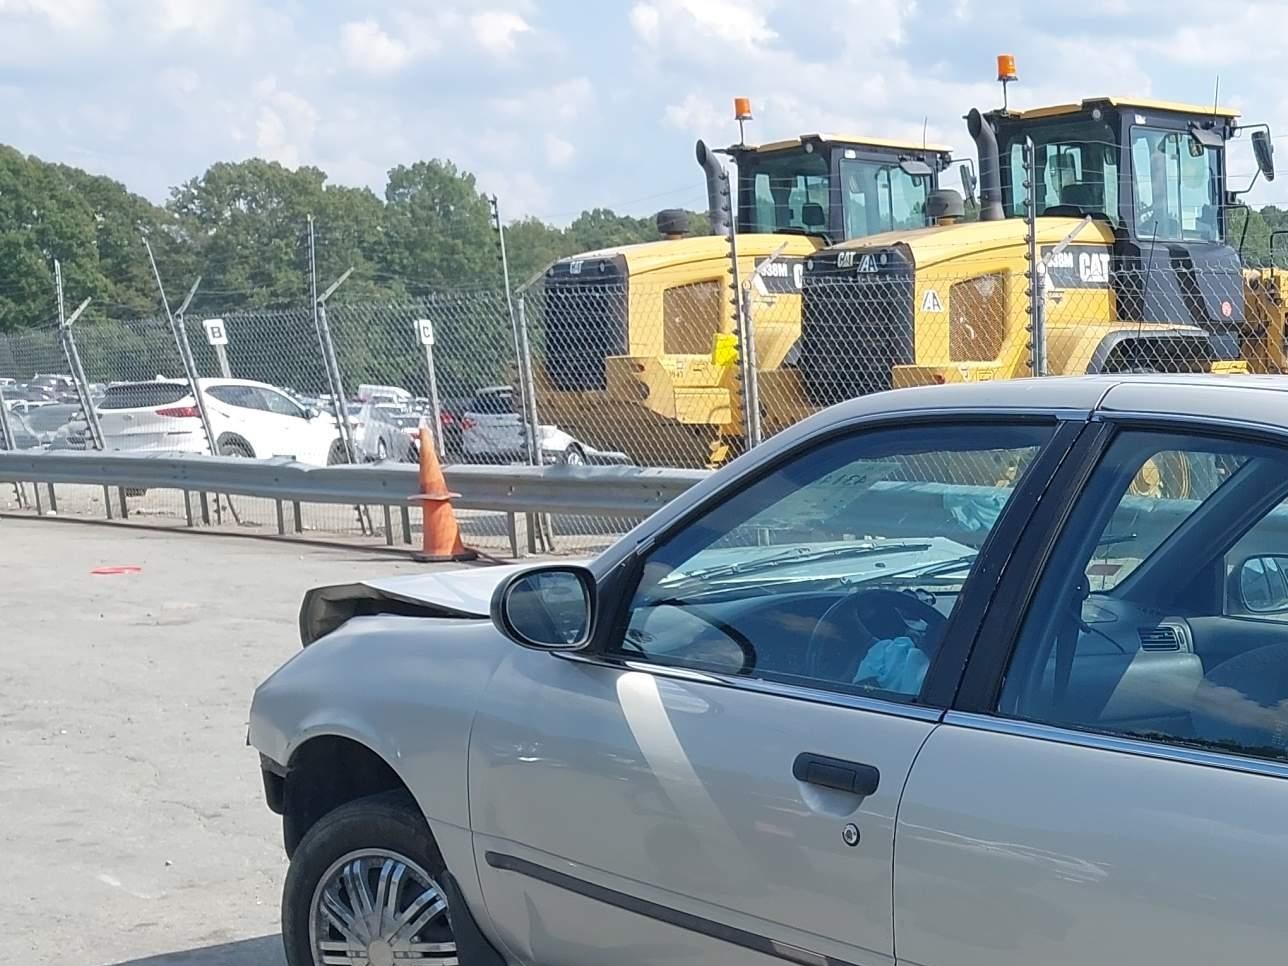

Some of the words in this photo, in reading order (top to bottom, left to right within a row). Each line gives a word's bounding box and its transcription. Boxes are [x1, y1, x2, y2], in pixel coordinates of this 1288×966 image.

[838, 251, 856, 268] CAT
[1079, 252, 1110, 283] CAT
[211, 326, 223, 339] B
[422, 326, 431, 338] C
